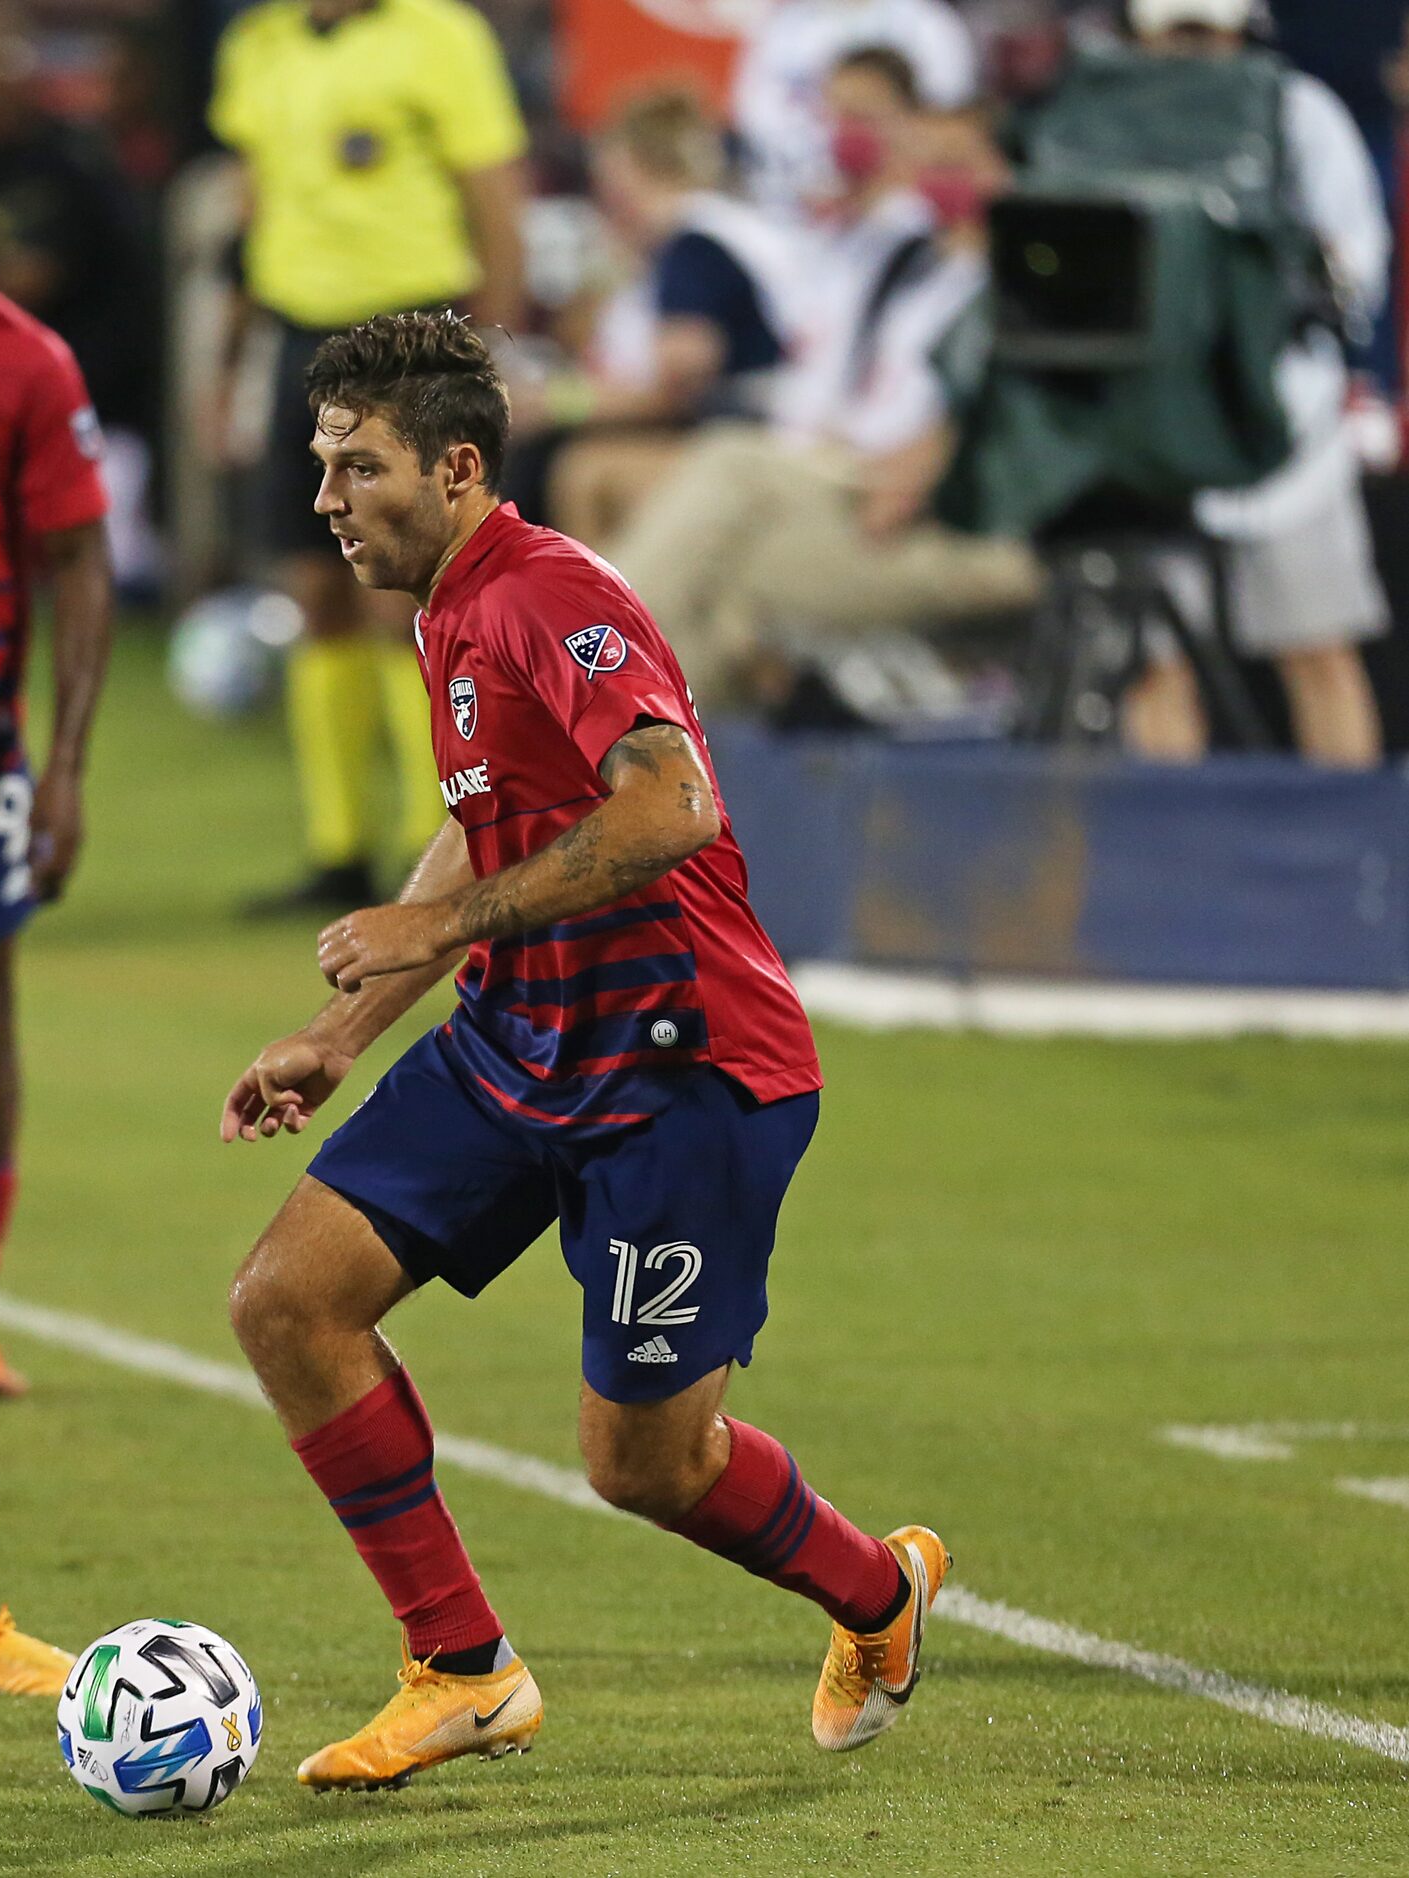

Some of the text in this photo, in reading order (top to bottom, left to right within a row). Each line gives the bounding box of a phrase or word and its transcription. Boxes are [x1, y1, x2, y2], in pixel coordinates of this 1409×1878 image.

[571, 630, 600, 650] MLS
[603, 646, 620, 660] 25
[657, 1029, 672, 1039] LH
[608, 1238, 701, 1325] 12
[627, 1352, 678, 1363] adidas
